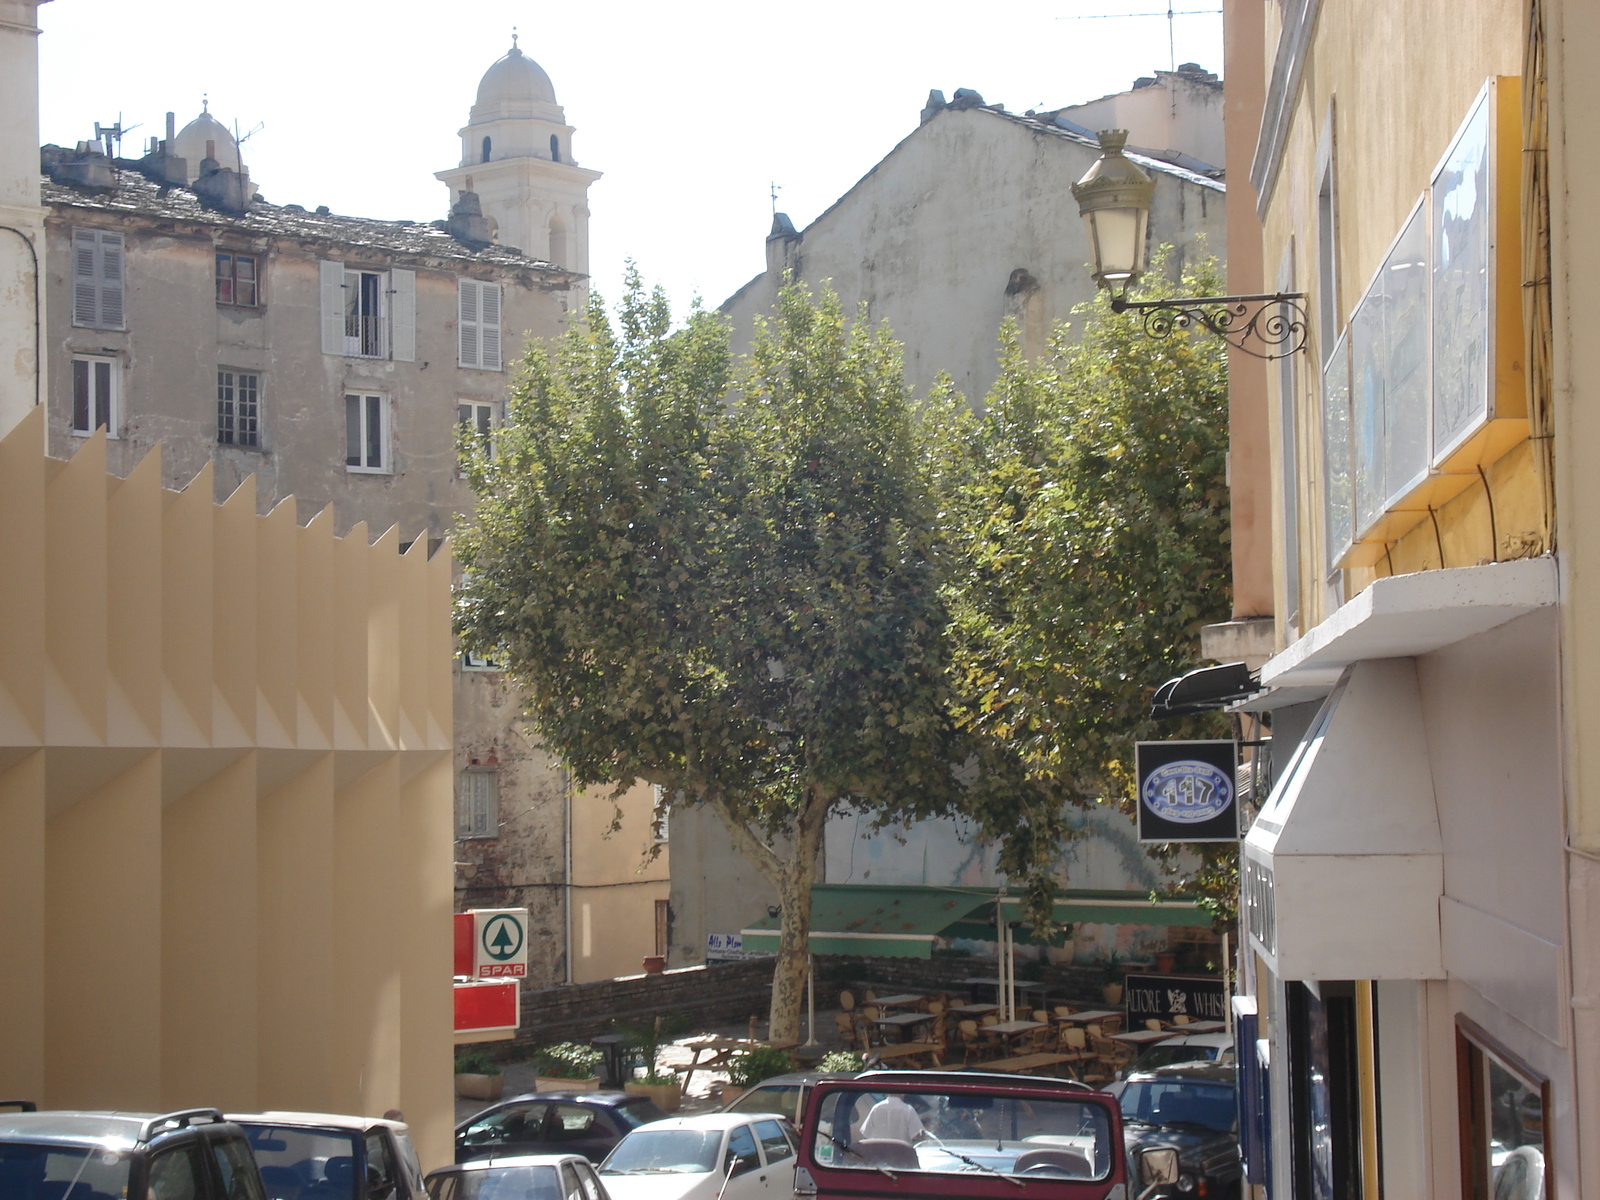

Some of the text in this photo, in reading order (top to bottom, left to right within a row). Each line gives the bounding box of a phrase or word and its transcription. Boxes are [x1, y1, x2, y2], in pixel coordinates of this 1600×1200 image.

[1163, 775, 1214, 805] 117
[481, 965, 523, 976] SPAR
[1127, 989, 1161, 1013] ALTORE
